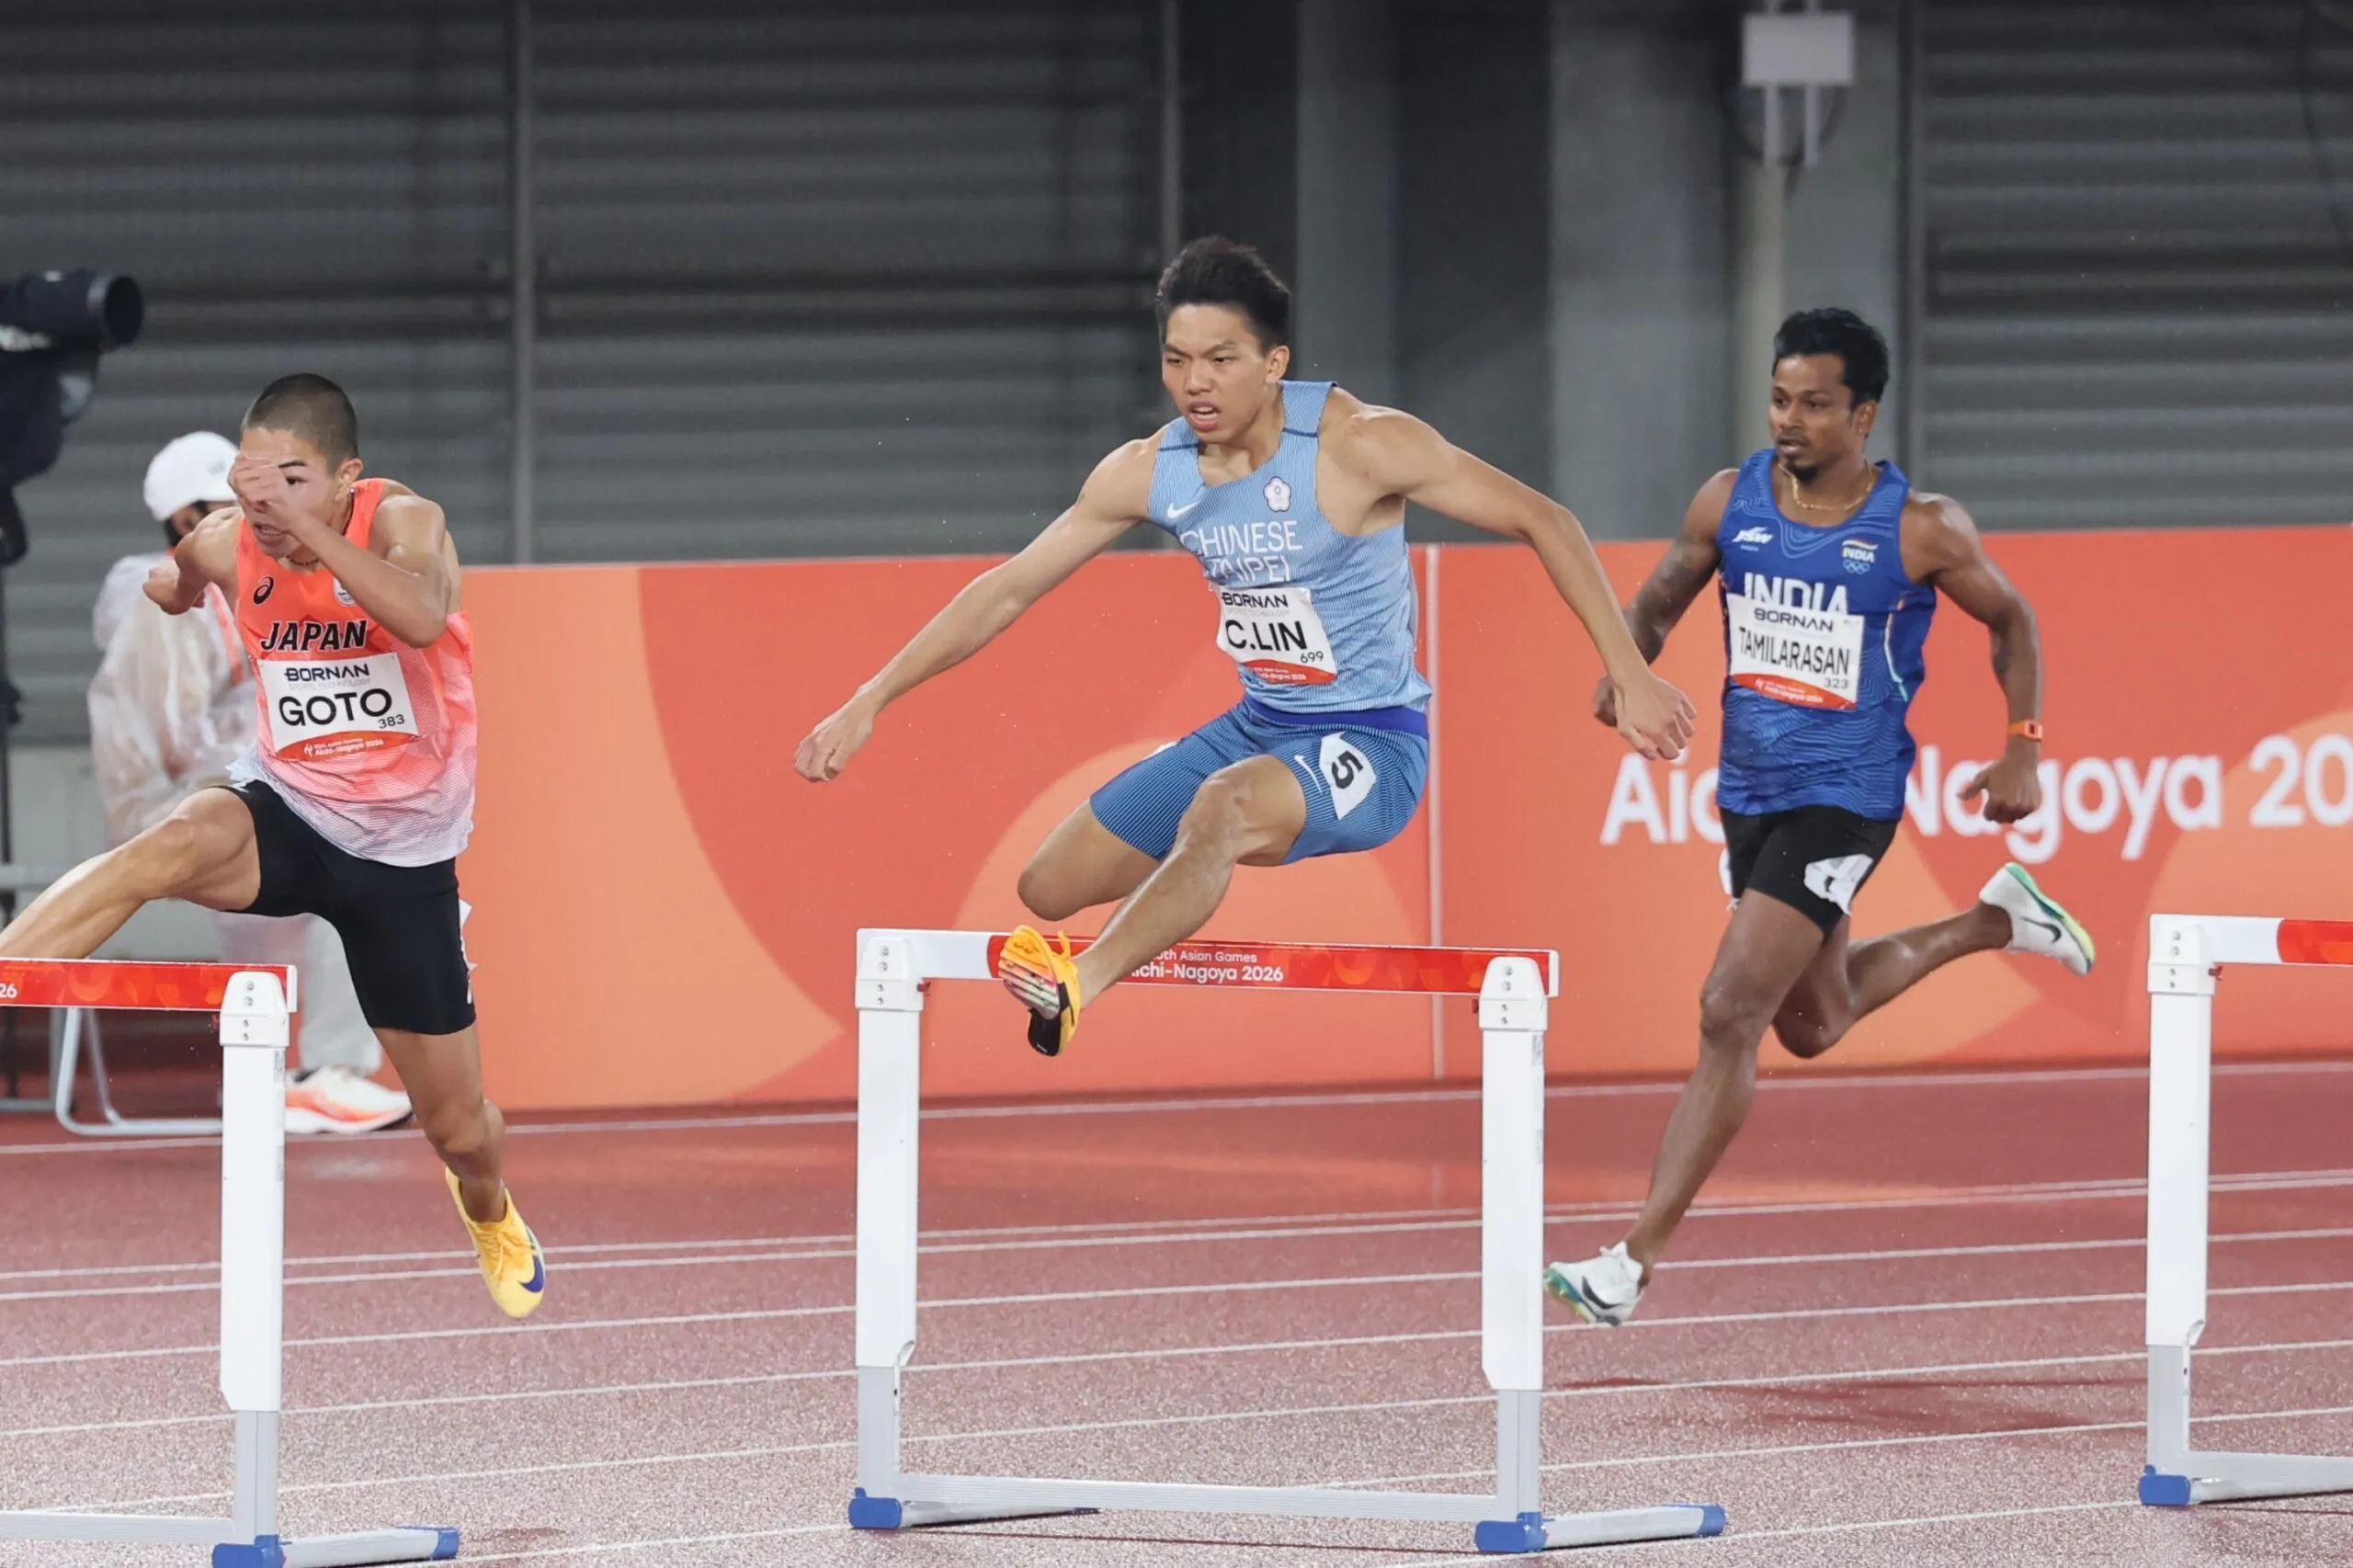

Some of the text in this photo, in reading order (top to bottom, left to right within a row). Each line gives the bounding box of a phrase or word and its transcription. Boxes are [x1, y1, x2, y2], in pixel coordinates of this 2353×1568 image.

[1179, 520, 1303, 557] CHINESE
[1842, 547, 1875, 563] INDIA
[1206, 555, 1290, 583] TAIPEI
[1222, 592, 1289, 608] BORNAN
[1744, 572, 1848, 615] INDIA
[1754, 608, 1834, 632] BORNAN
[260, 619, 367, 652] JAPAN
[1225, 619, 1308, 651] C.LIN
[1300, 651, 1324, 663] 699
[1739, 626, 1850, 676] TAMILARASAN
[284, 664, 369, 682] BORNAN
[1824, 677, 1849, 689] 323
[278, 688, 392, 726] GOTO
[379, 714, 405, 729] 383
[1332, 750, 1364, 790] 5
[1180, 950, 1211, 961] Asian
[1215, 951, 1257, 963] Games
[1131, 961, 1284, 984] chi-Nagoya 2026
